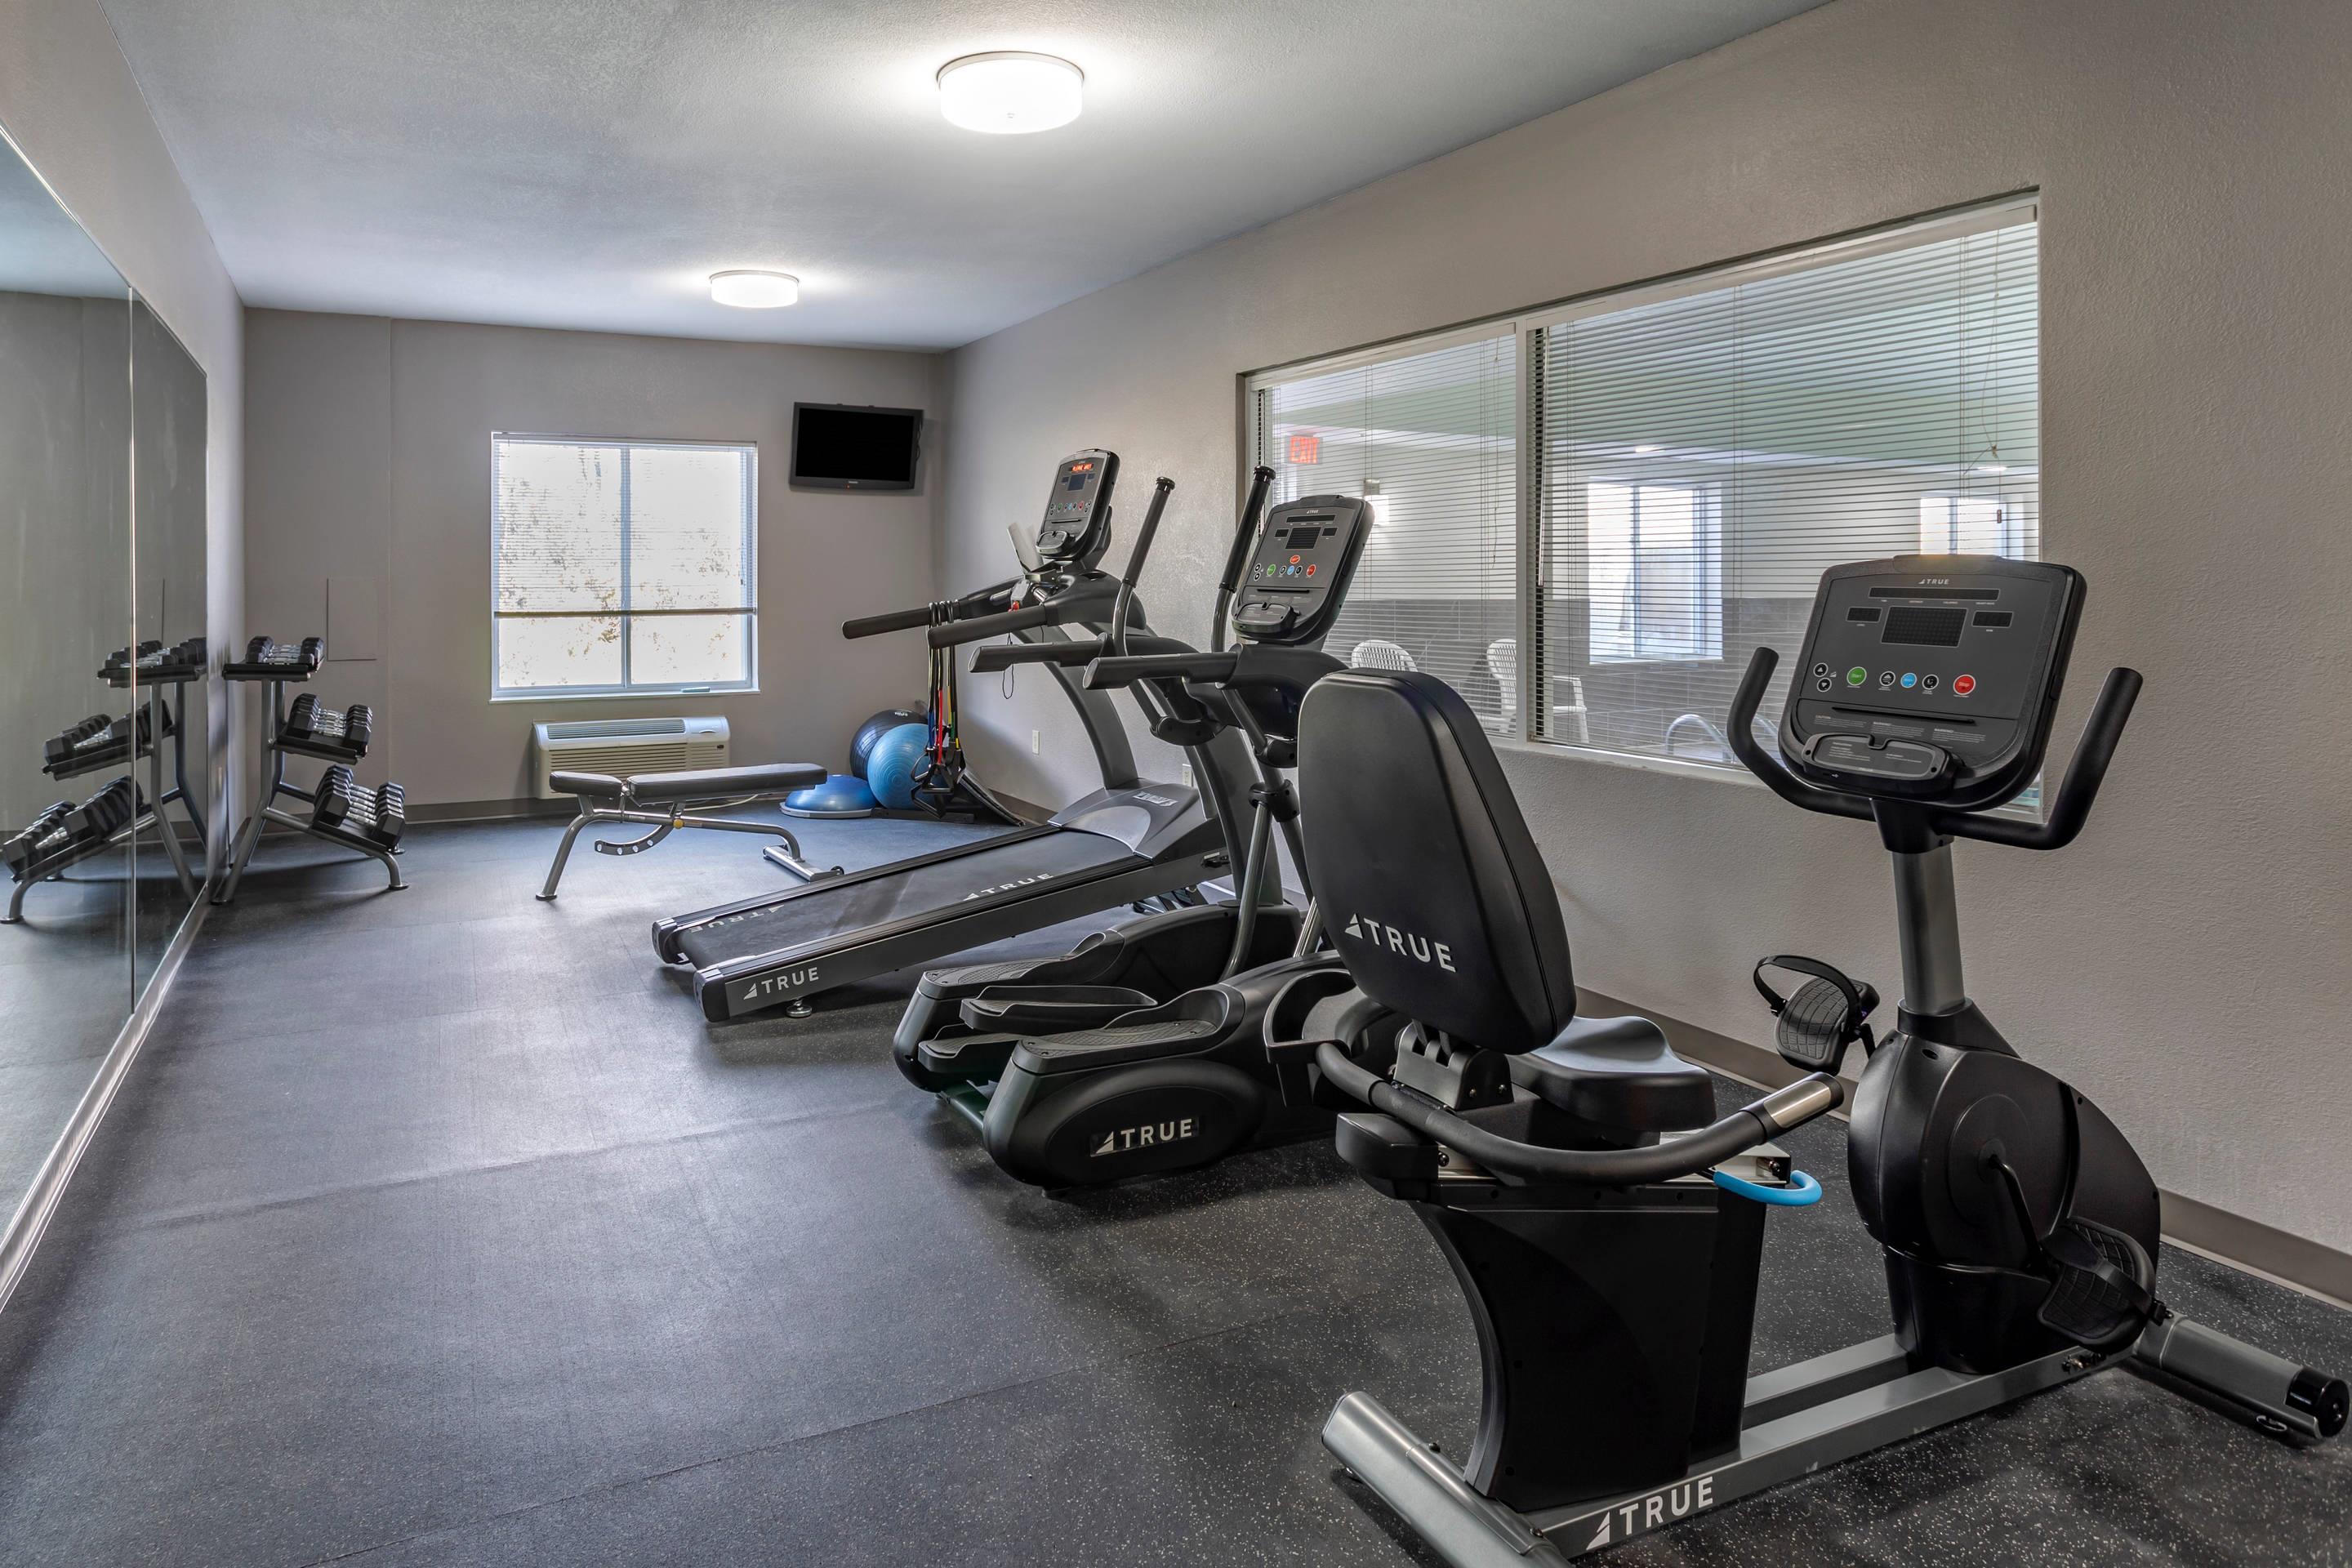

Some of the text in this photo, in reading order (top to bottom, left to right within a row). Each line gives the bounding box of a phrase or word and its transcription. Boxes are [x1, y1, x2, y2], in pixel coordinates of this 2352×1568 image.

[1290, 436, 1319, 464] EXIT
[981, 873, 1054, 894] TRUE
[688, 911, 764, 933] TRUE
[1363, 917, 1456, 973] TRUE
[761, 967, 819, 994] TRUE
[1120, 1119, 1192, 1148] TRUE
[1619, 1476, 1713, 1535] TRUE
